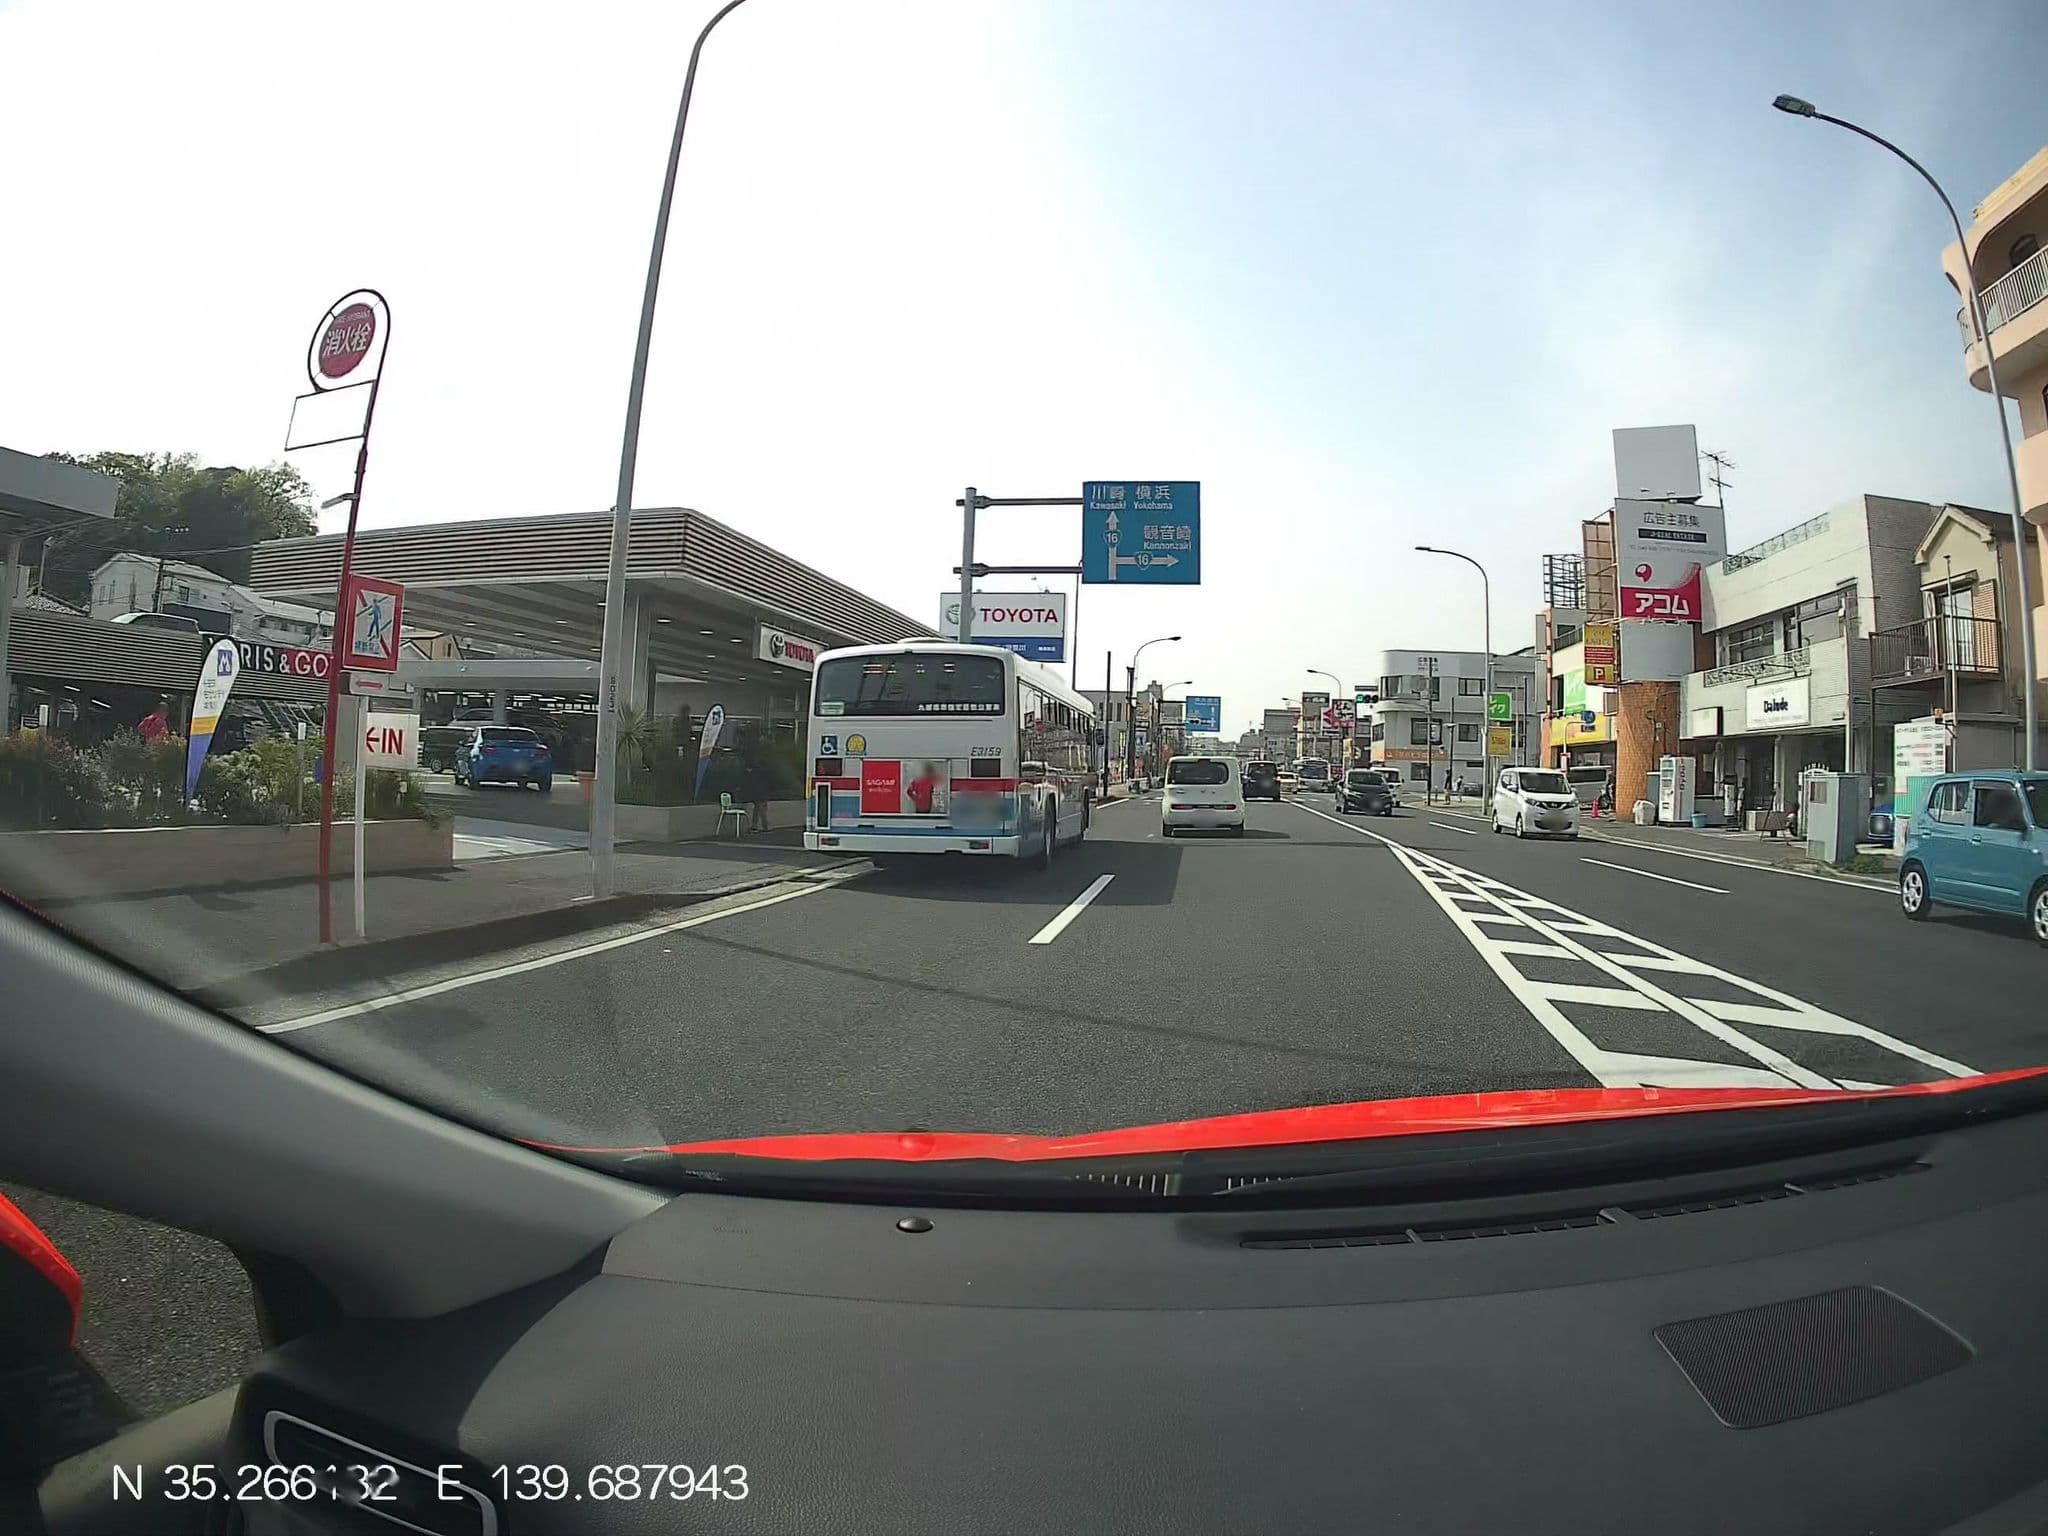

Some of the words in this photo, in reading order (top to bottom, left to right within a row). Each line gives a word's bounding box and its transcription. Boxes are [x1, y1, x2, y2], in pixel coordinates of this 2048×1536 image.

[323, 323, 371, 356] 消火栓
[1092, 485, 1125, 500] 川崎
[1136, 485, 1170, 500] 横浜
[1090, 502, 1126, 510] Kawasaki
[1134, 501, 1173, 510] Yokohama
[1643, 512, 1701, 528] 広告主募集
[1107, 533, 1118, 543] 16
[1143, 525, 1191, 540] 観音崎
[1138, 555, 1148, 565] 16
[1635, 592, 1690, 616] アコム
[979, 608, 1058, 623] TOYOTA
[785, 640, 815, 664] TOYOTA
[279, 655, 291, 674] &
[295, 652, 329, 677] GO
[1595, 668, 1604, 680] P
[382, 728, 404, 755] IN
[971, 747, 1002, 757] E3159
